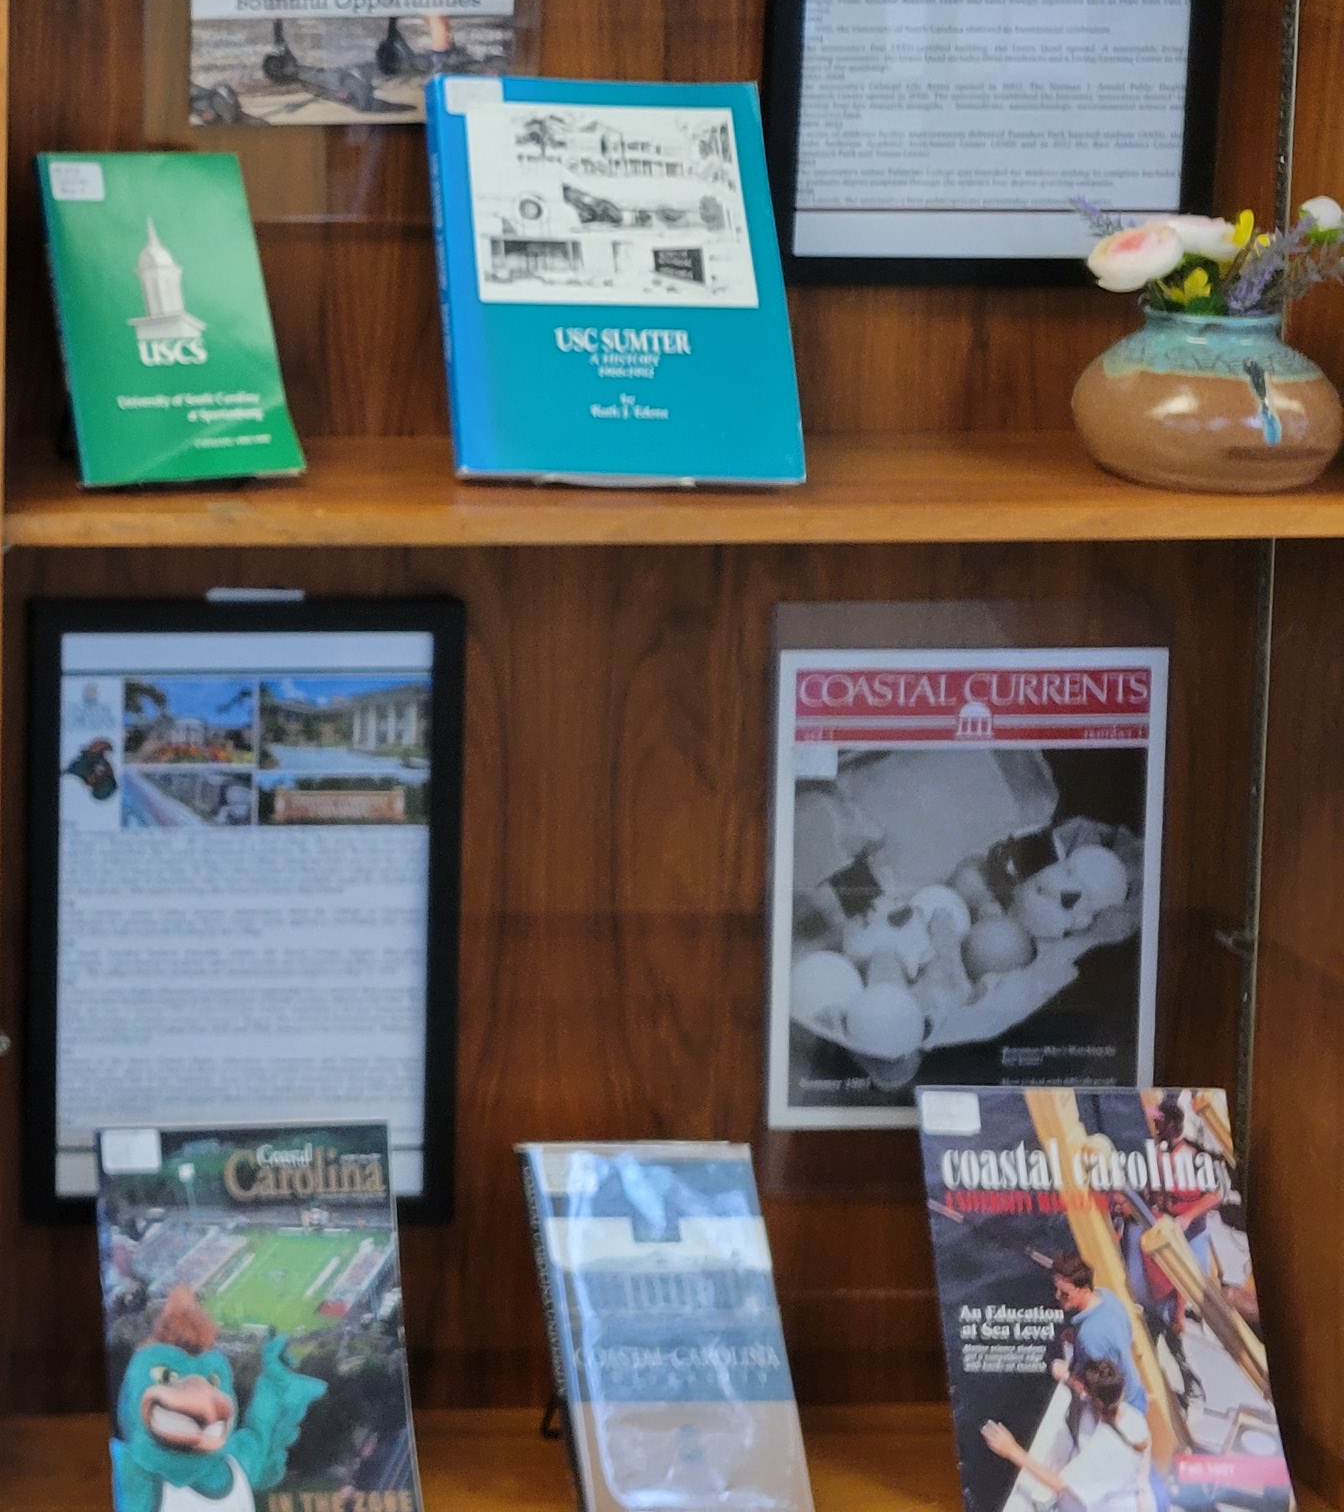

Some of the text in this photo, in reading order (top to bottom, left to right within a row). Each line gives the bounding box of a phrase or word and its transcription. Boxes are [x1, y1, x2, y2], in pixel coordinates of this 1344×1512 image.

[139, 340, 207, 366] USCS
[555, 327, 691, 355] USC SUMTER
[799, 670, 1149, 709] COASTAL CURRENTS
[256, 1142, 312, 1168] Coastal
[942, 1138, 1220, 1191] coastal carolina
[224, 1146, 386, 1203] Carolina
[960, 1304, 1064, 1323] An Education
[962, 1322, 1055, 1338] at Sea Level
